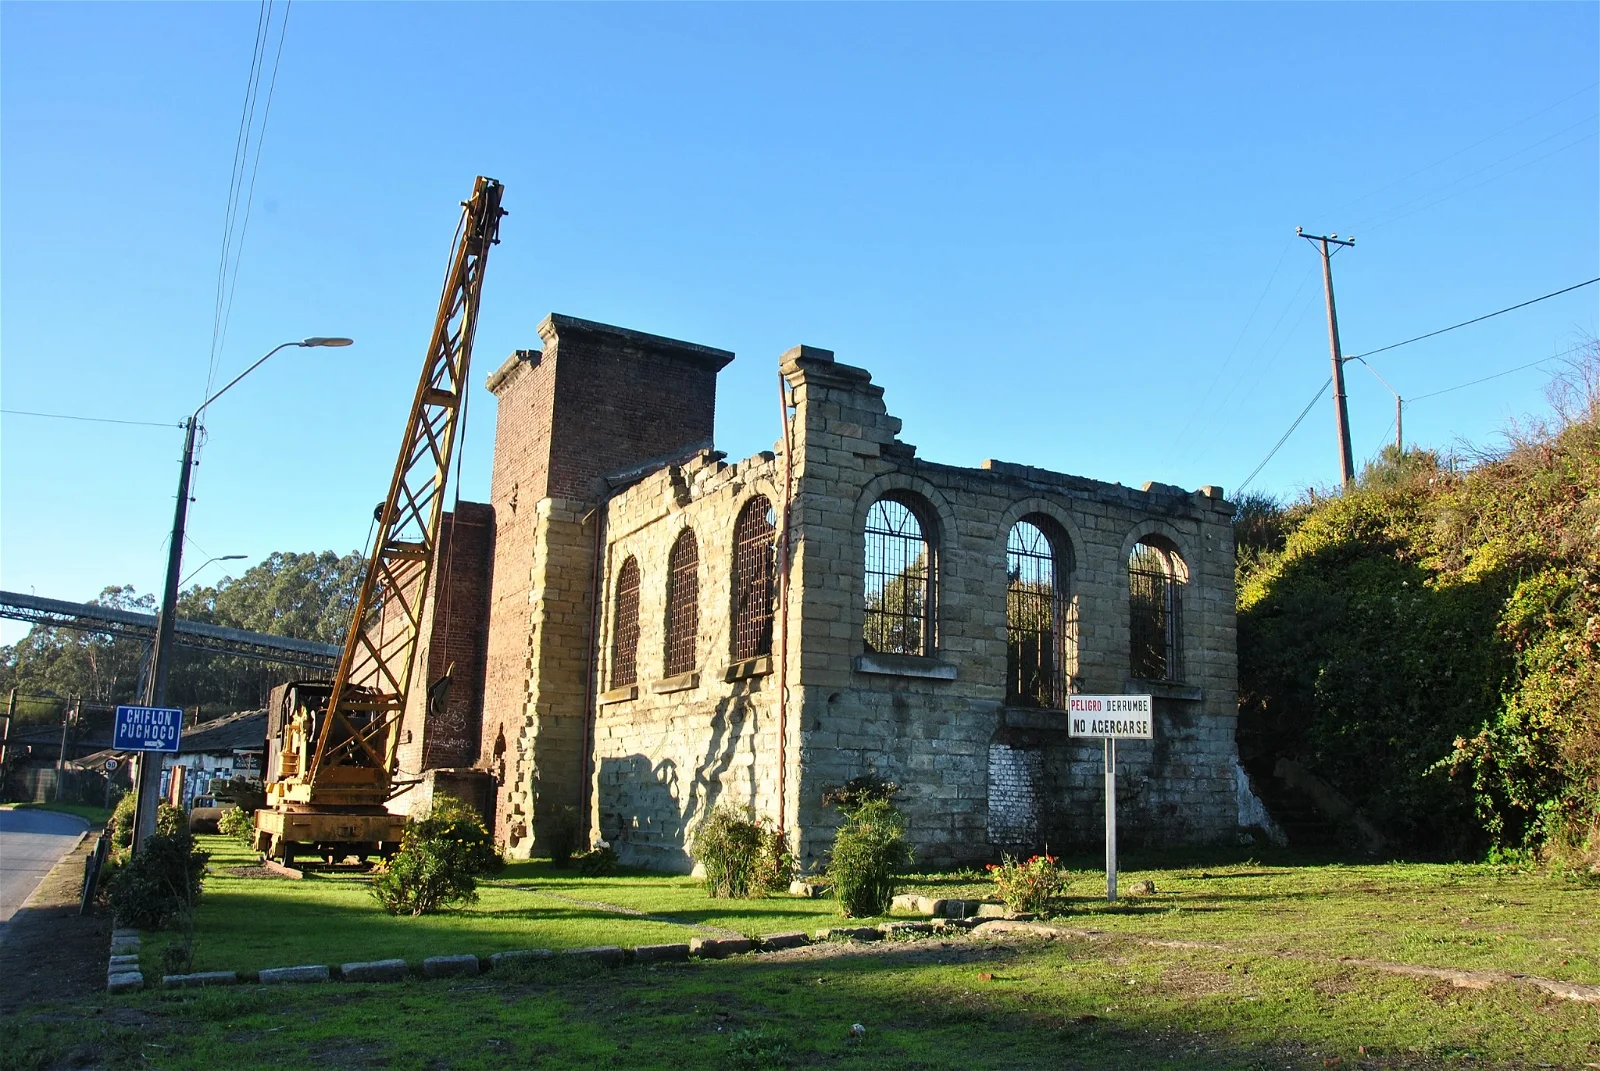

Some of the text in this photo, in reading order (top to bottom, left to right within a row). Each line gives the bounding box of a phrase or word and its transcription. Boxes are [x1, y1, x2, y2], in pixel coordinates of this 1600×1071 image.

[1071, 699, 1148, 712] PELIGRO DERRUMBE
[126, 709, 172, 726] CHIFLON
[120, 722, 175, 740] PUCHOCO
[1073, 718, 1148, 734] NO ACERCARSE
[107, 761, 116, 769] 50
